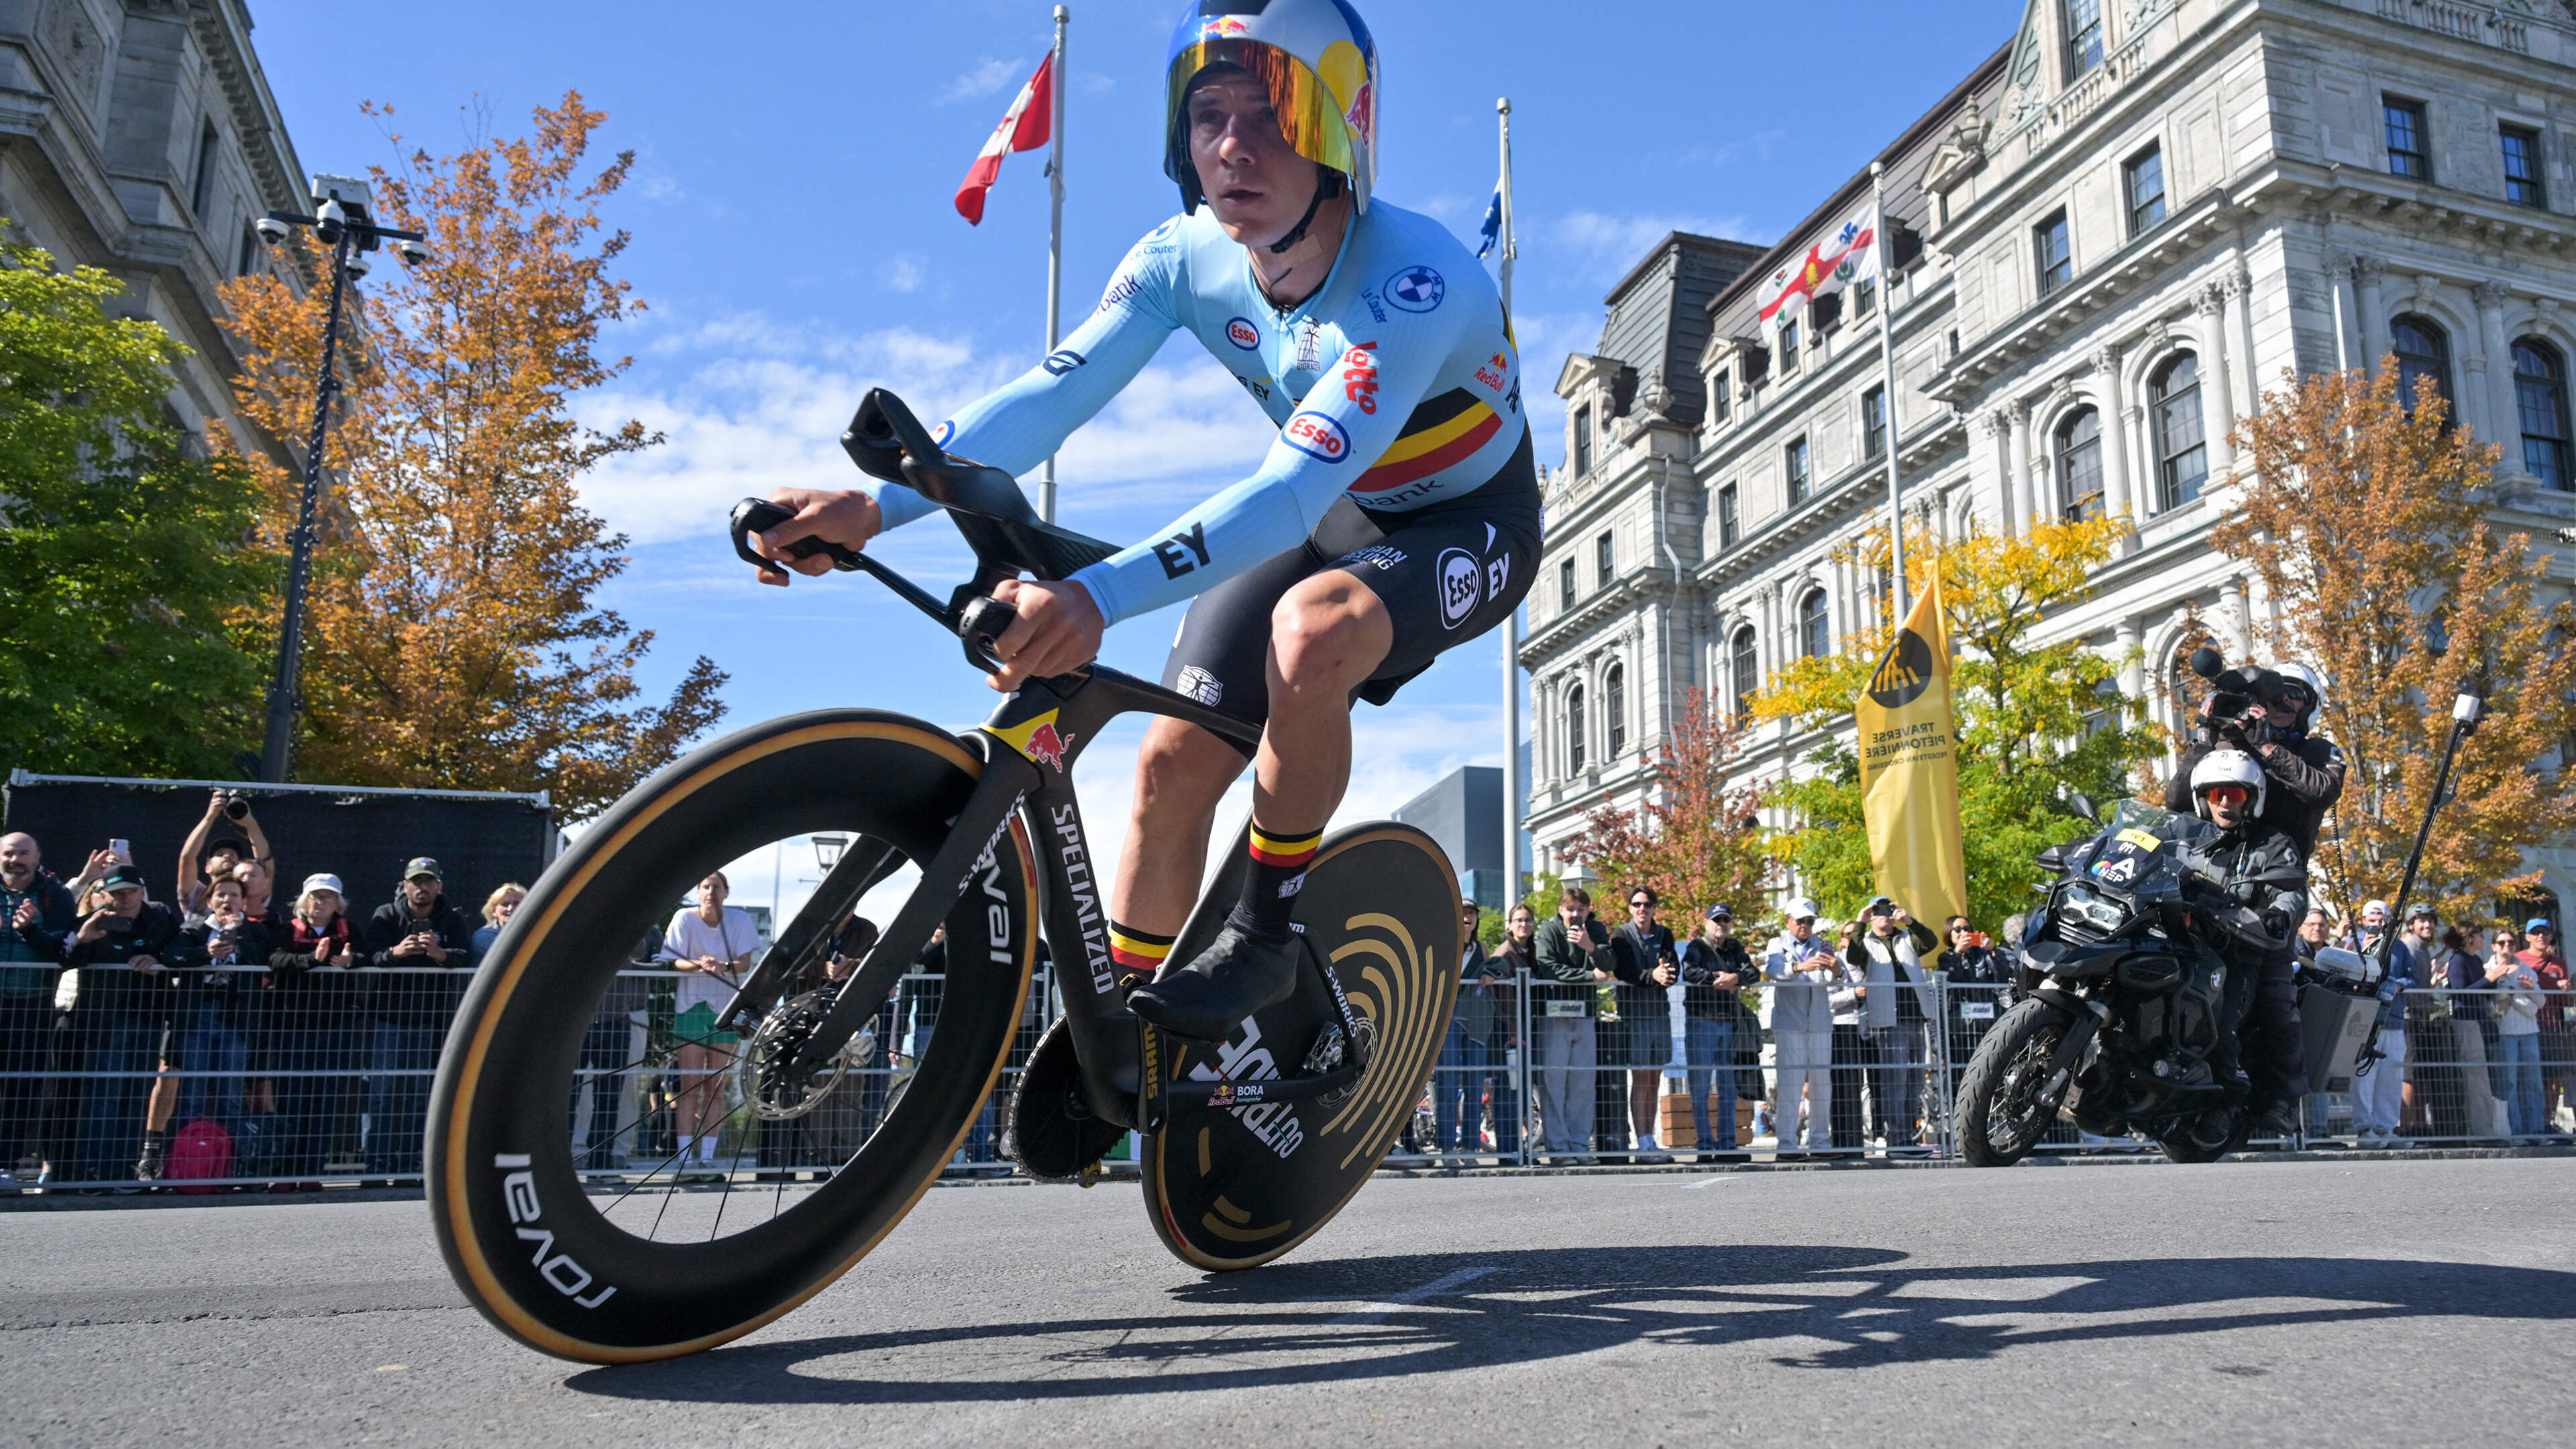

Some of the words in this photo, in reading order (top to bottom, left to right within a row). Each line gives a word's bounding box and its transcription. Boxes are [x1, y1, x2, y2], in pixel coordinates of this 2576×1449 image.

[1144, 244, 1177, 254] Couter
[1417, 268, 1441, 303] BMW
[1231, 324, 1256, 343] Esso
[1253, 381, 1270, 400] EY
[1290, 418, 1341, 454] Esso
[1150, 521, 1211, 580] EY
[1447, 570, 1477, 608] Esso
[1488, 552, 1509, 602] EY
[959, 788, 1025, 897] S-WORKS
[2074, 843, 2094, 858] F
[2098, 867, 2125, 883] NEP
[2111, 857, 2135, 879] A
[1051, 804, 1114, 994] SPECIALIZED
[1325, 966, 1359, 1038] S-WORKS
[1144, 1025, 1158, 1099] SRAM
[1237, 1085, 1264, 1095] BORA
[494, 1153, 617, 1309] roval
